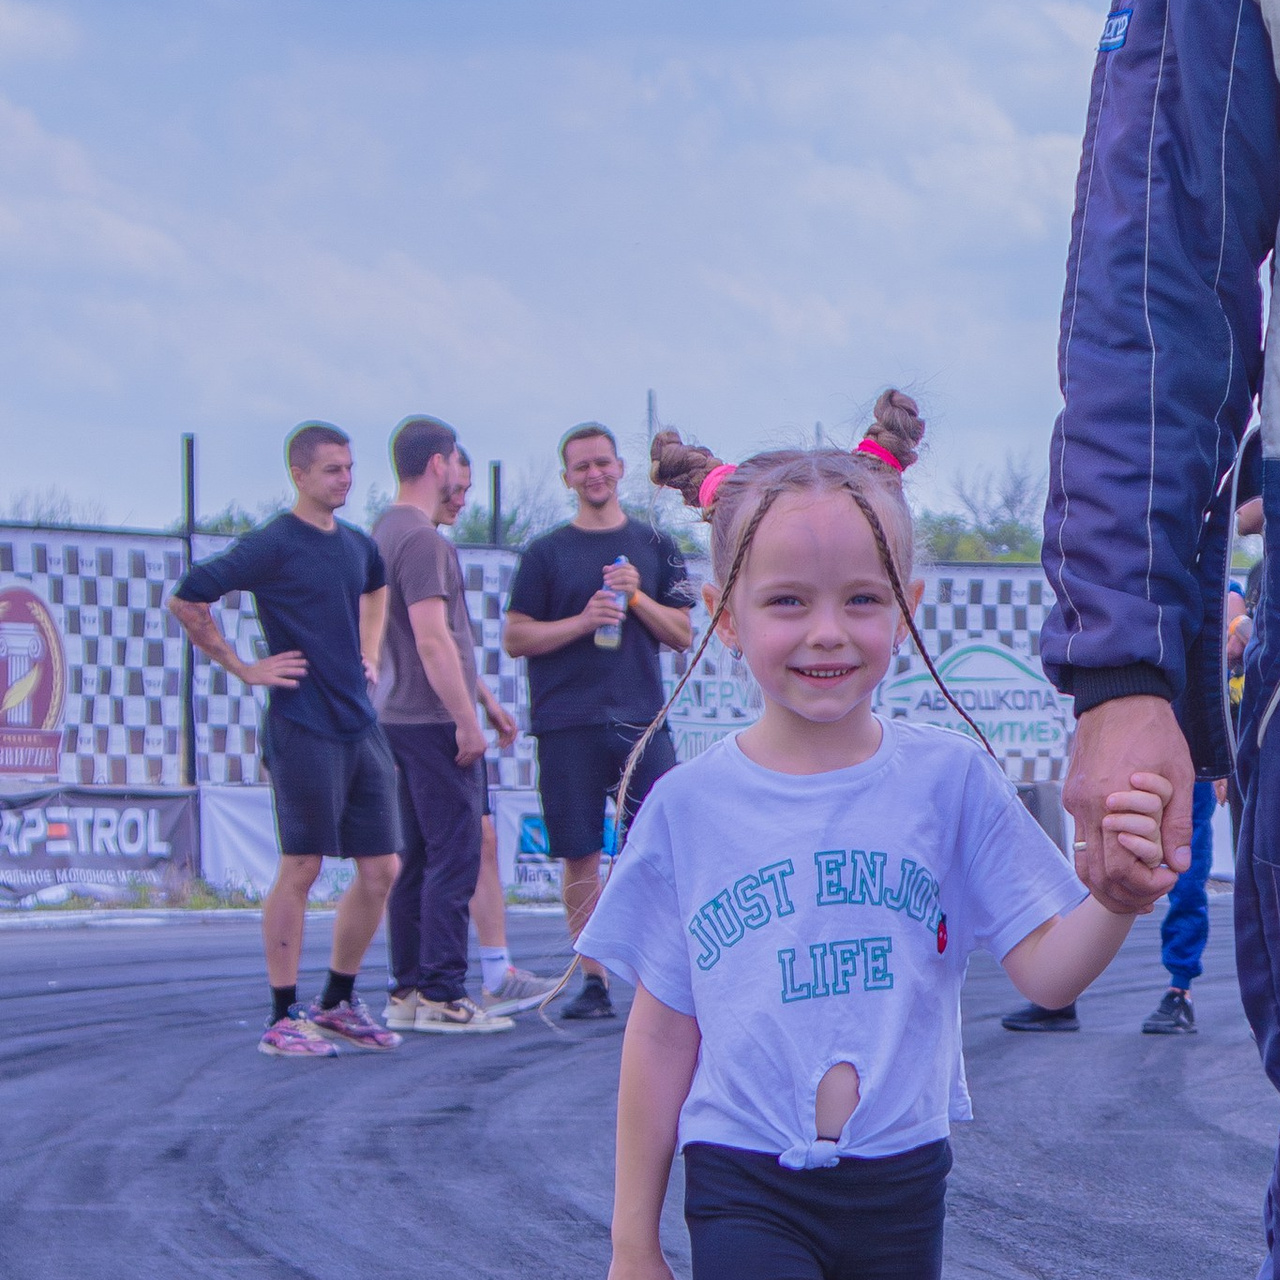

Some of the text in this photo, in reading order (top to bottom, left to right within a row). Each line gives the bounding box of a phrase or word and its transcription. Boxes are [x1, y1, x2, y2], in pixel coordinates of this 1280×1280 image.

[915, 689, 1060, 711] АВТОШКОЛА
[688, 858, 795, 971] JUST
[777, 936, 894, 1004] LIFE
